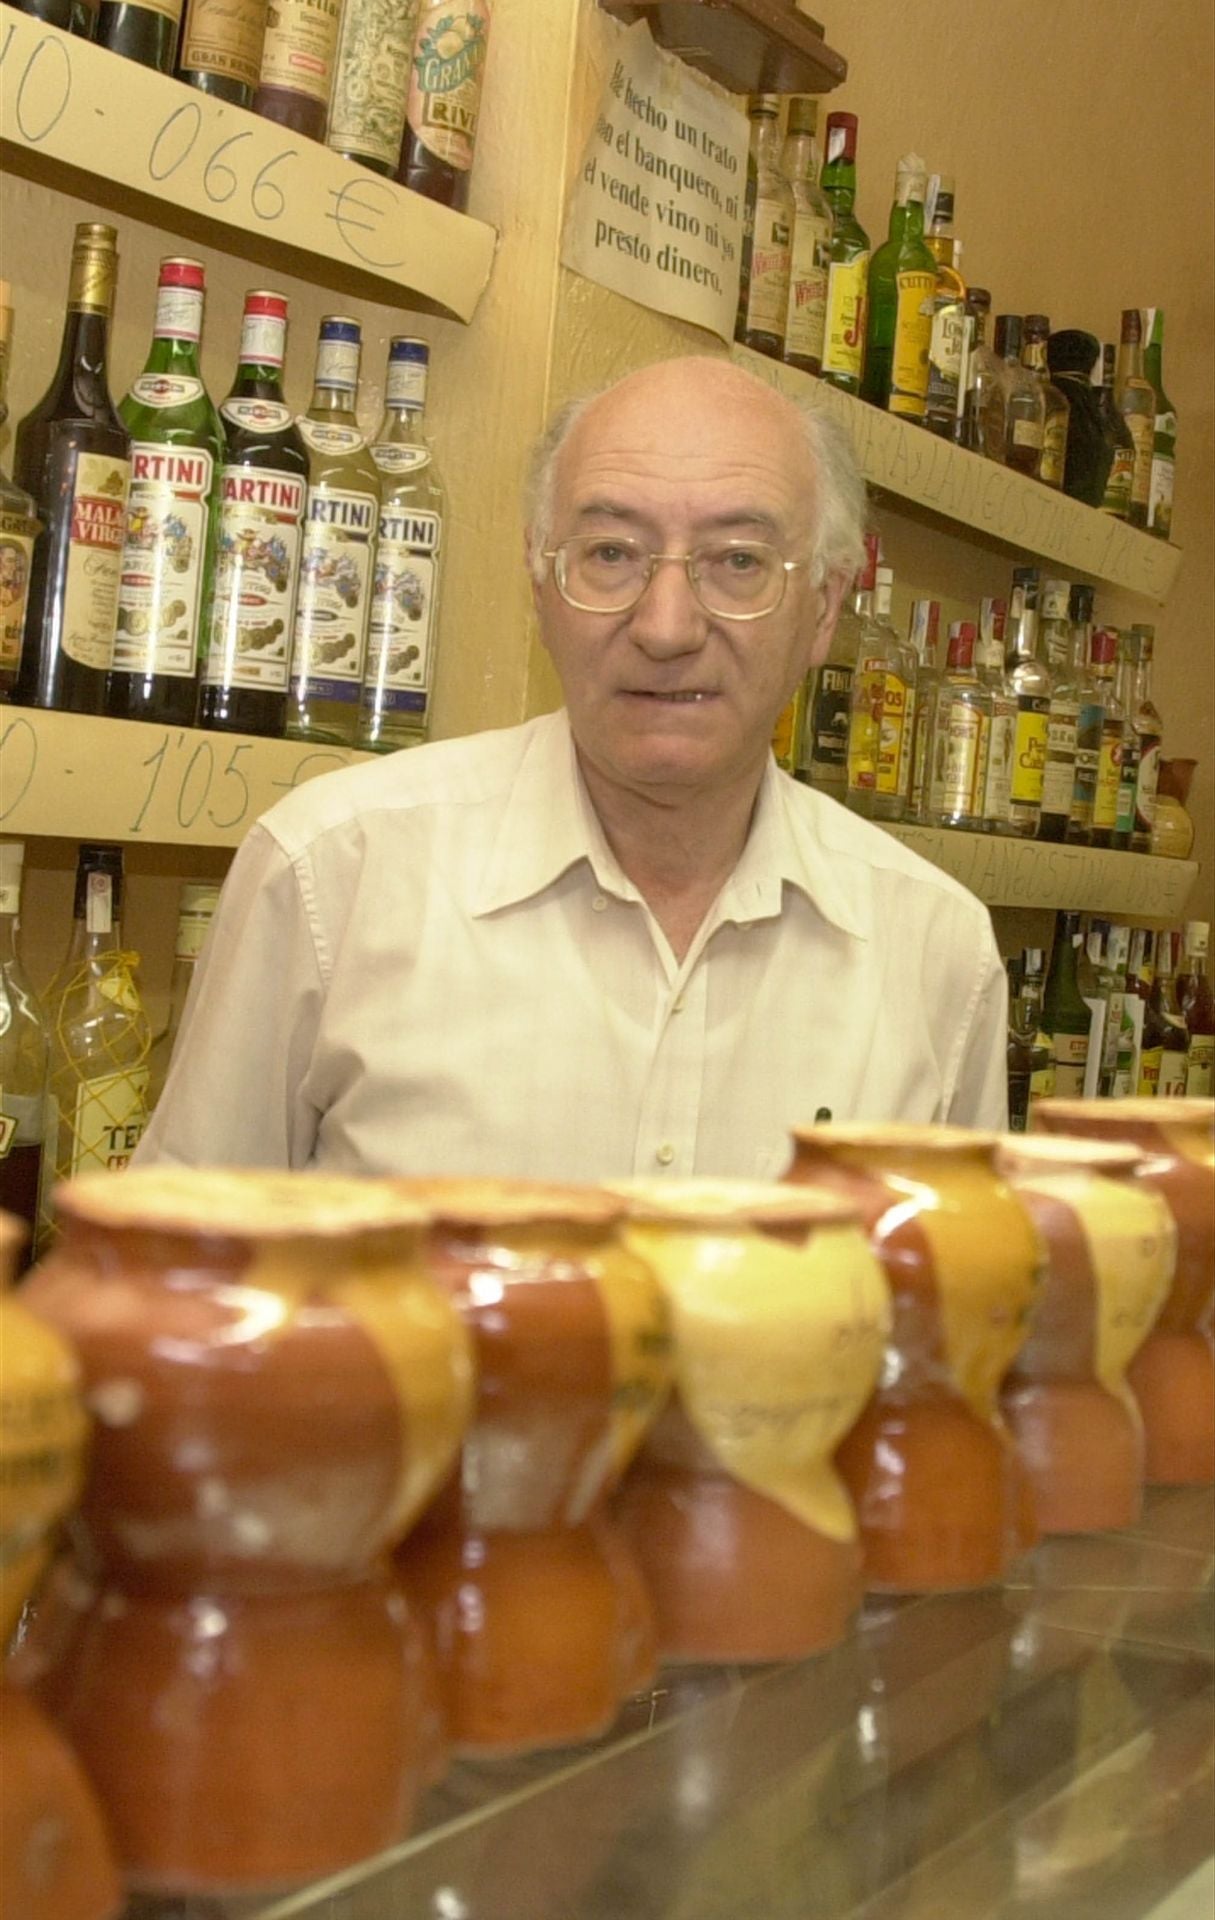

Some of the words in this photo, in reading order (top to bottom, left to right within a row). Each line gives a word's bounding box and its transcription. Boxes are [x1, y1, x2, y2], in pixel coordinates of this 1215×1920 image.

[615, 130, 631, 158] el
[624, 76, 668, 132] hecho
[674, 119, 697, 147] un
[701, 131, 738, 174] trato
[600, 171, 650, 217] vende
[655, 200, 701, 237] vino
[704, 223, 719, 248] ni
[594, 219, 651, 264] presto
